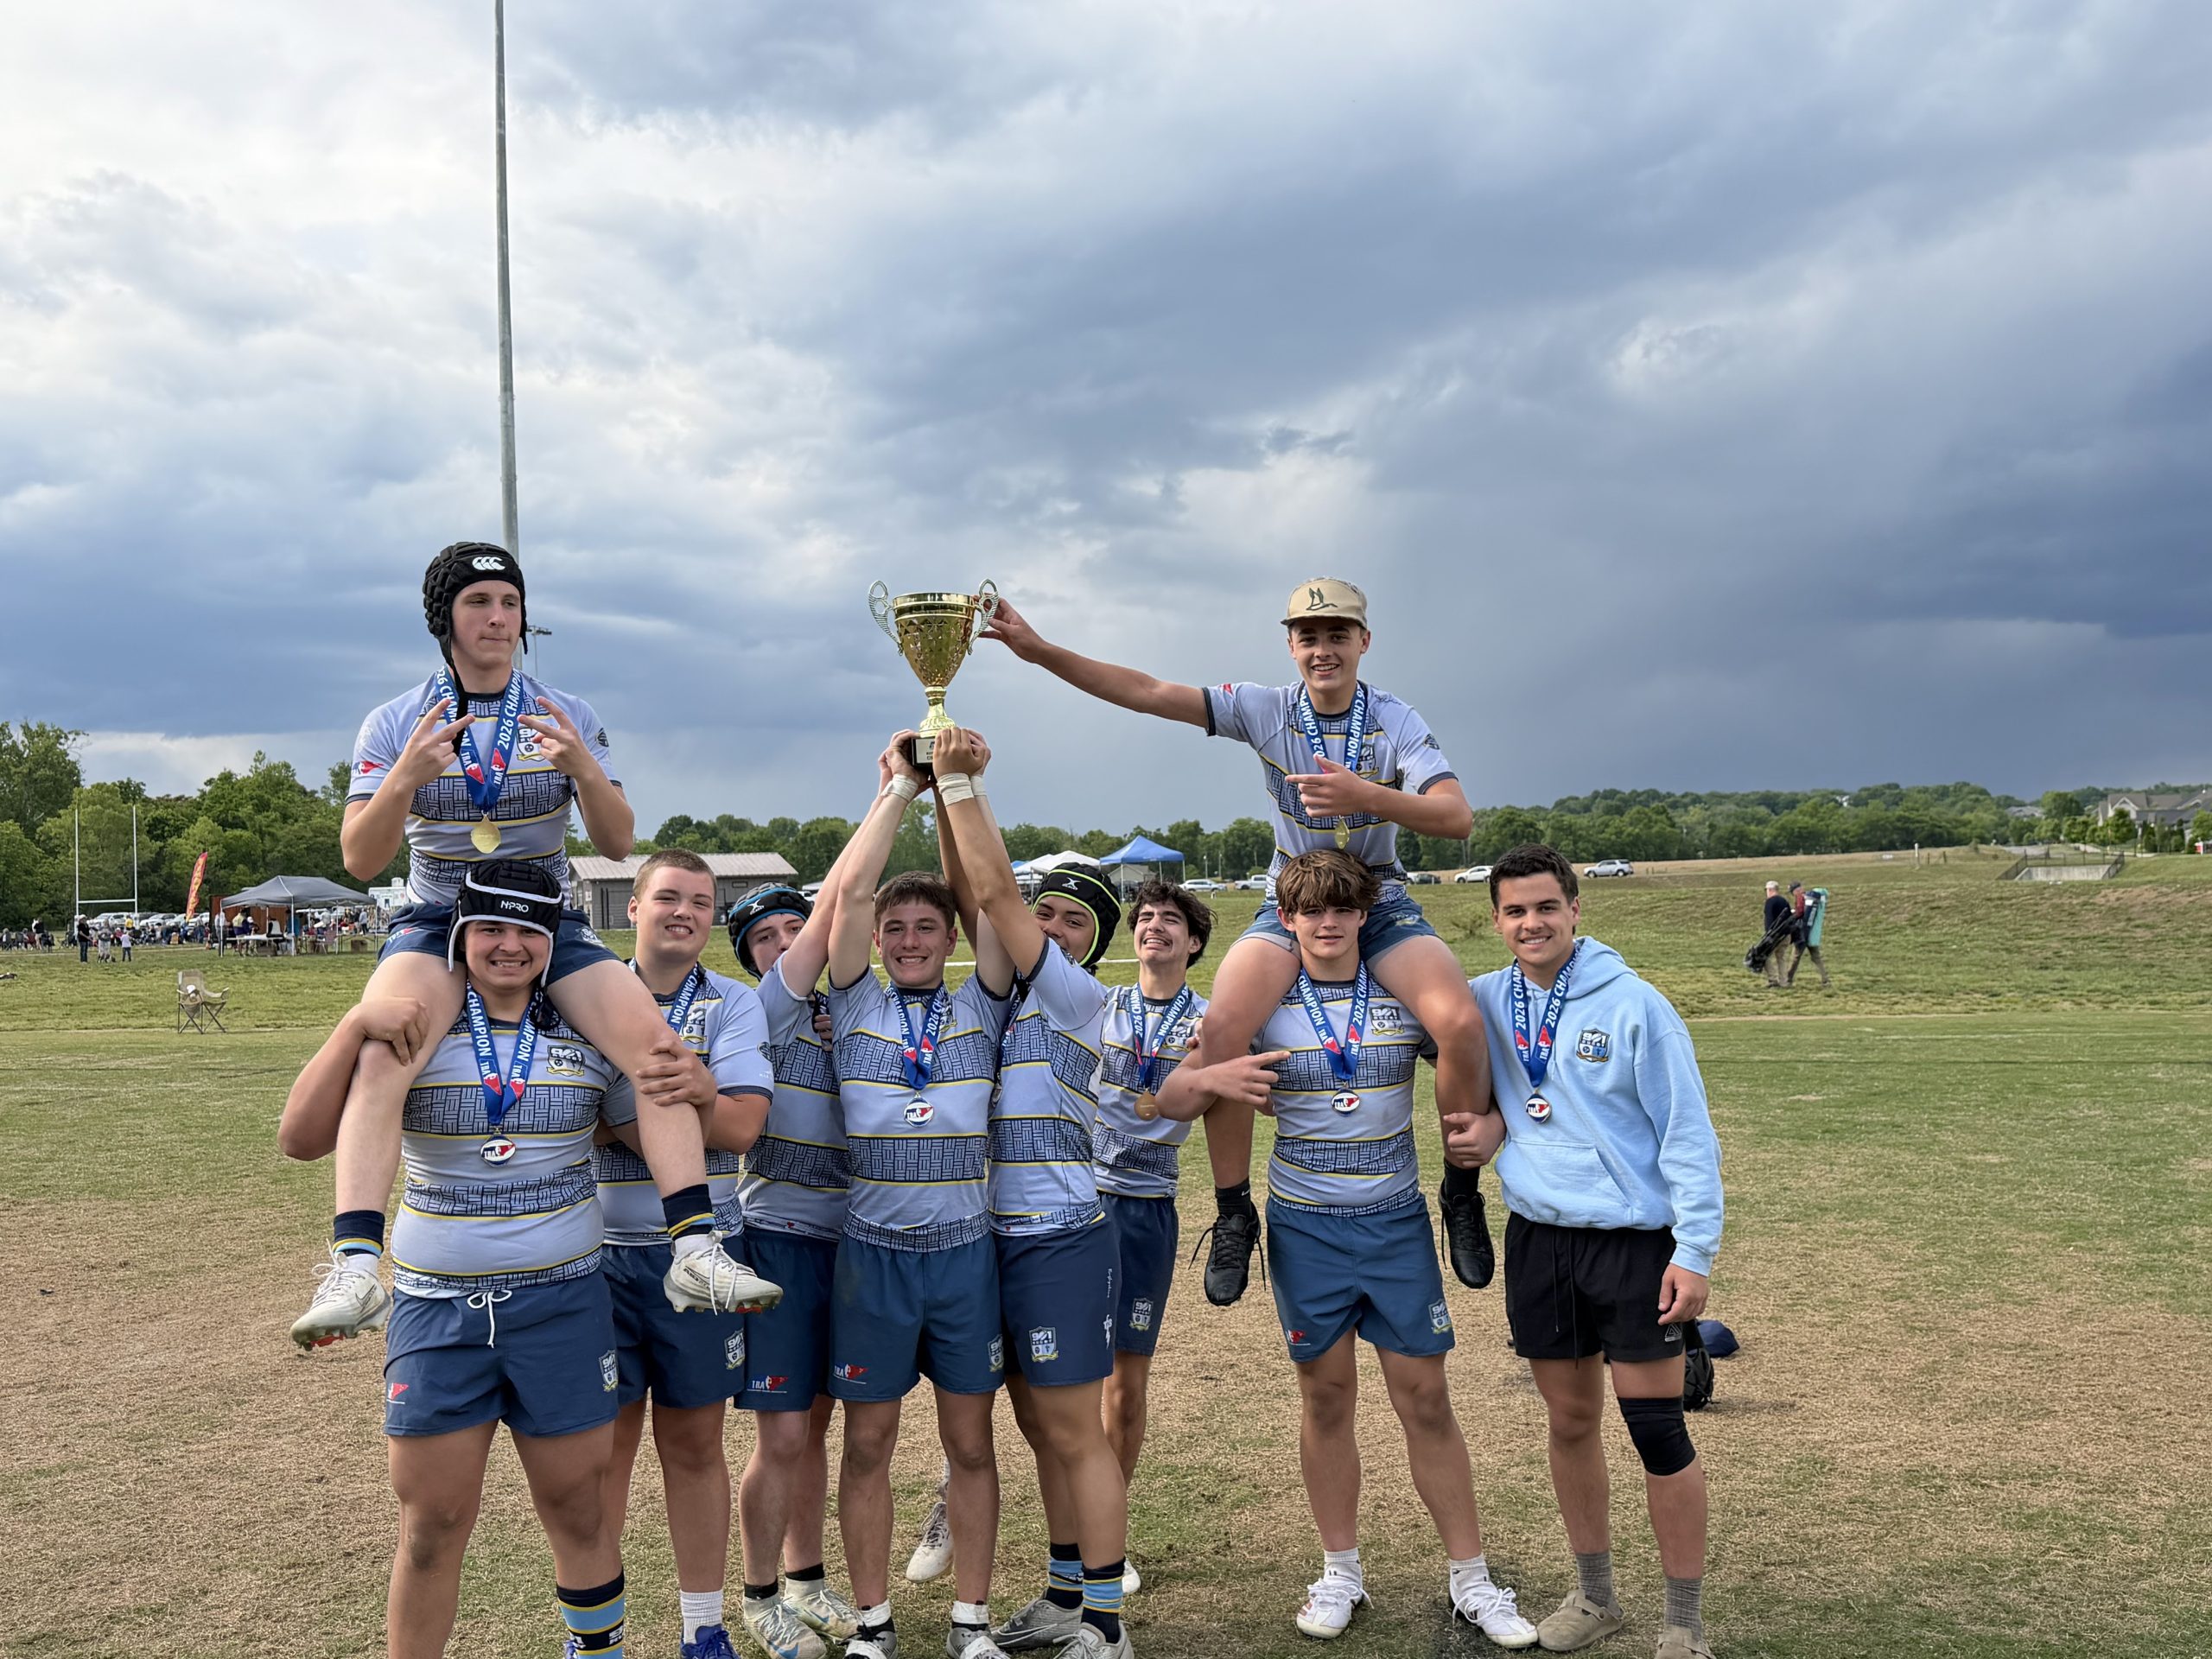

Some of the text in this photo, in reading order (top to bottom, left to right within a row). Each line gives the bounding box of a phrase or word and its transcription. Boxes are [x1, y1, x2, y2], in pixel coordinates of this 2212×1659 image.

[498, 718, 514, 750] 2026
[1346, 700, 1365, 759] CHAMPION
[1311, 737, 1325, 758] 026
[671, 975, 698, 1024] CHAMPION
[1158, 995, 1185, 1036] CHAMPION
[1298, 975, 1325, 1027] CHAMPION
[1352, 998, 1365, 1027] 2026
[1515, 1001, 1527, 1030] 2026
[1545, 996, 1561, 1028] 2026
[467, 991, 493, 1057] CHAMPION
[925, 1012, 939, 1036] 2026
[1134, 1014, 1143, 1038] 2026
